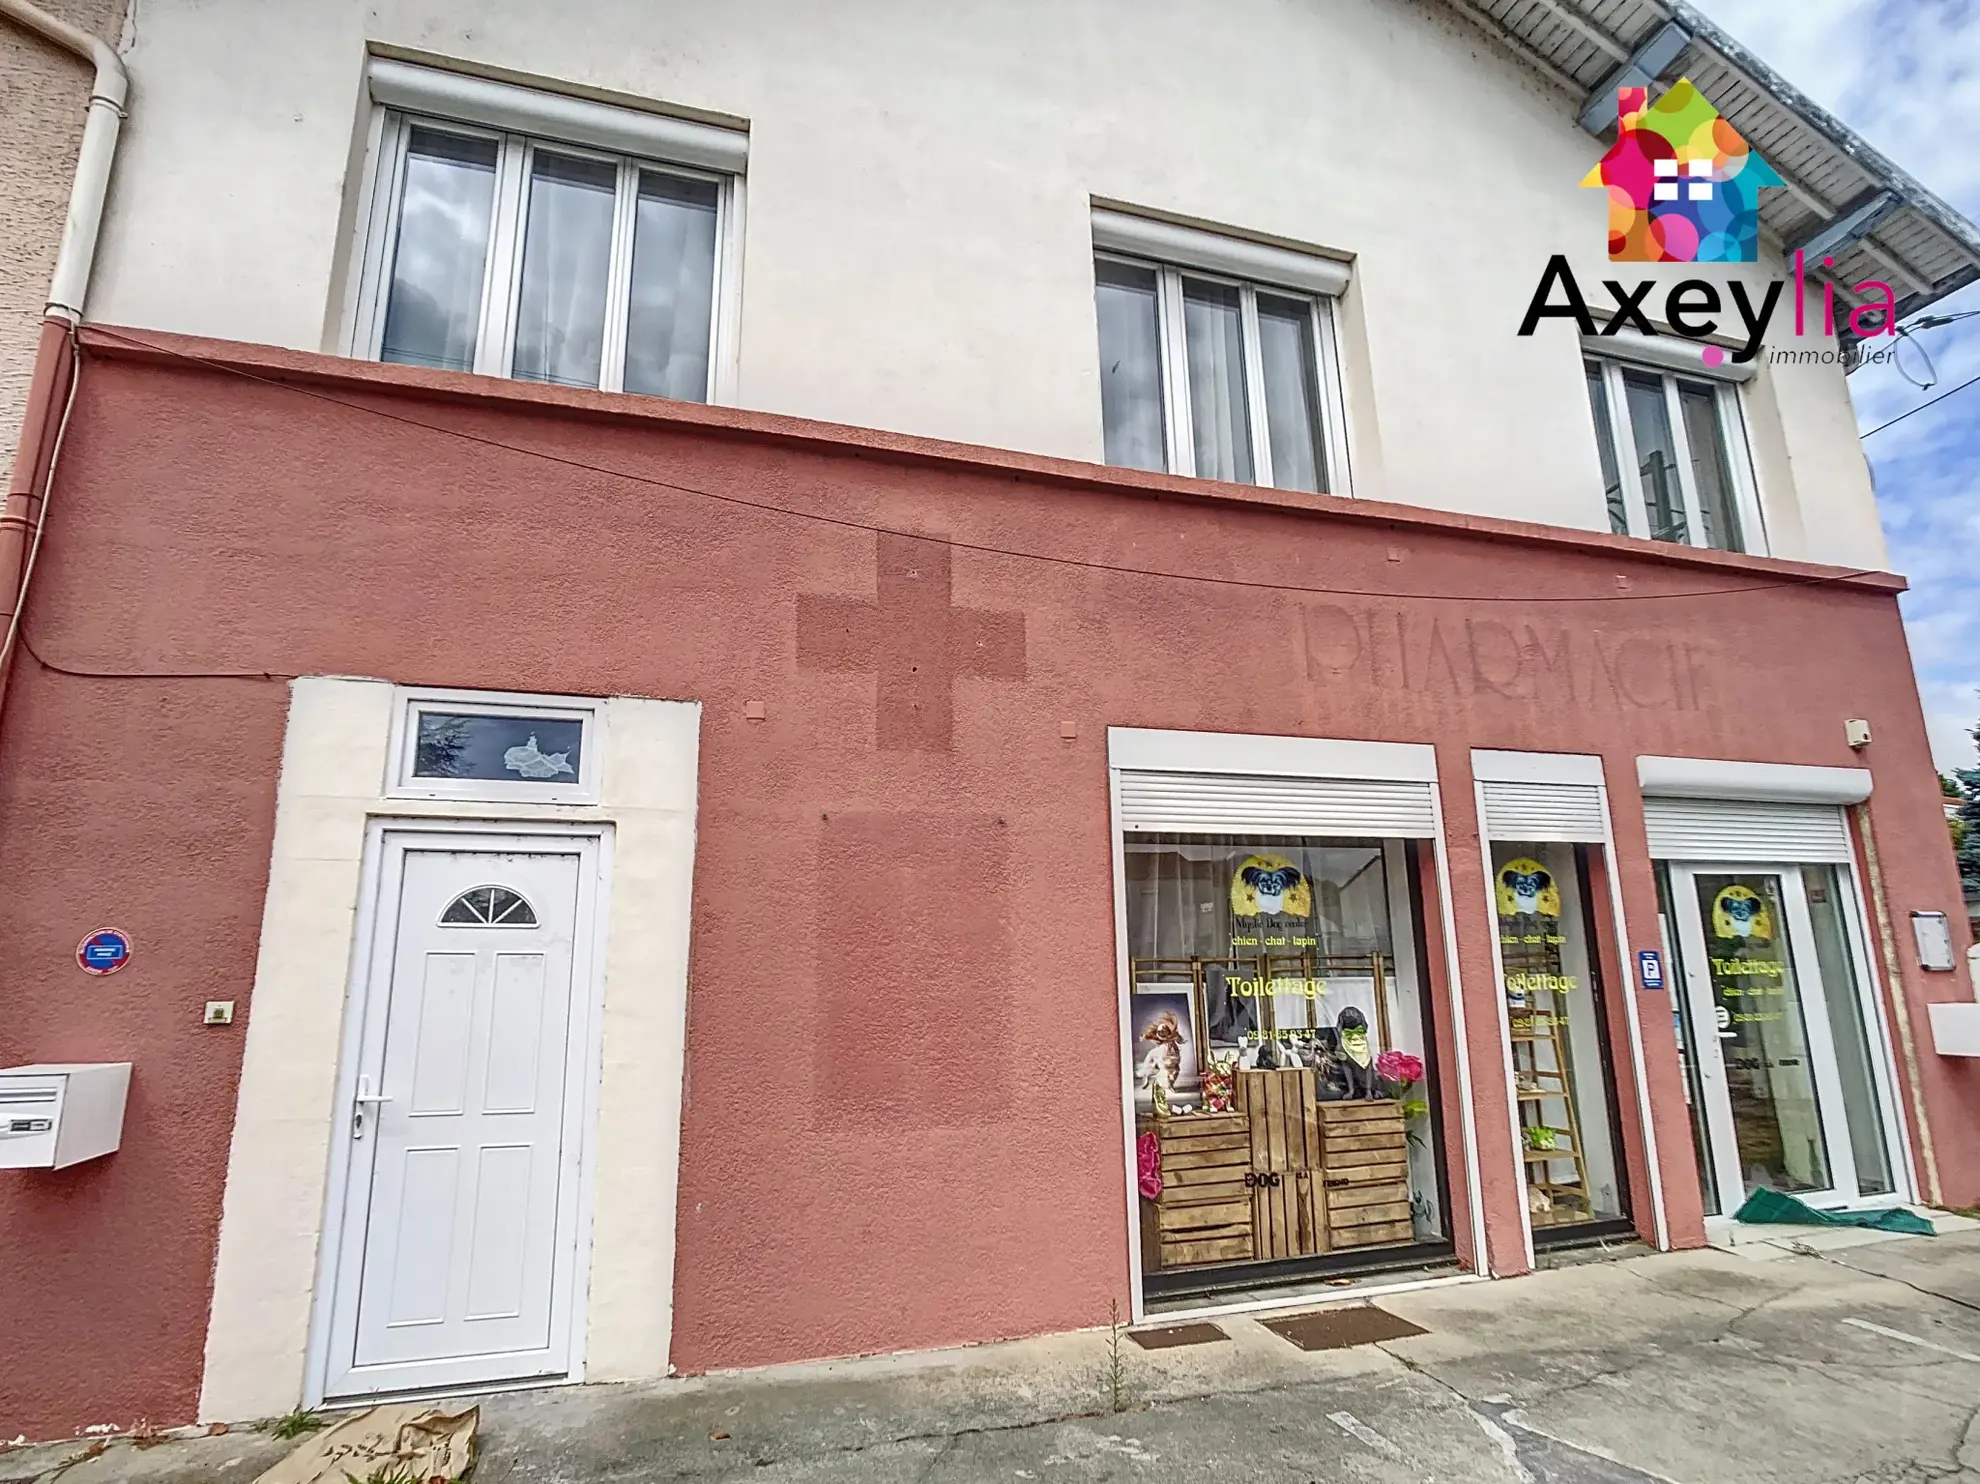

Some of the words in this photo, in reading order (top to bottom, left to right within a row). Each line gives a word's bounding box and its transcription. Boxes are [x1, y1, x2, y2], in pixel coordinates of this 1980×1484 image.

[1231, 936, 1258, 946] chien
[1264, 936, 1287, 946] chat
[1292, 936, 1317, 948] lapin
[1225, 976, 1328, 1000] Toilettage
[1504, 972, 1578, 994] oilettage
[1244, 1172, 1280, 1188] DOG
